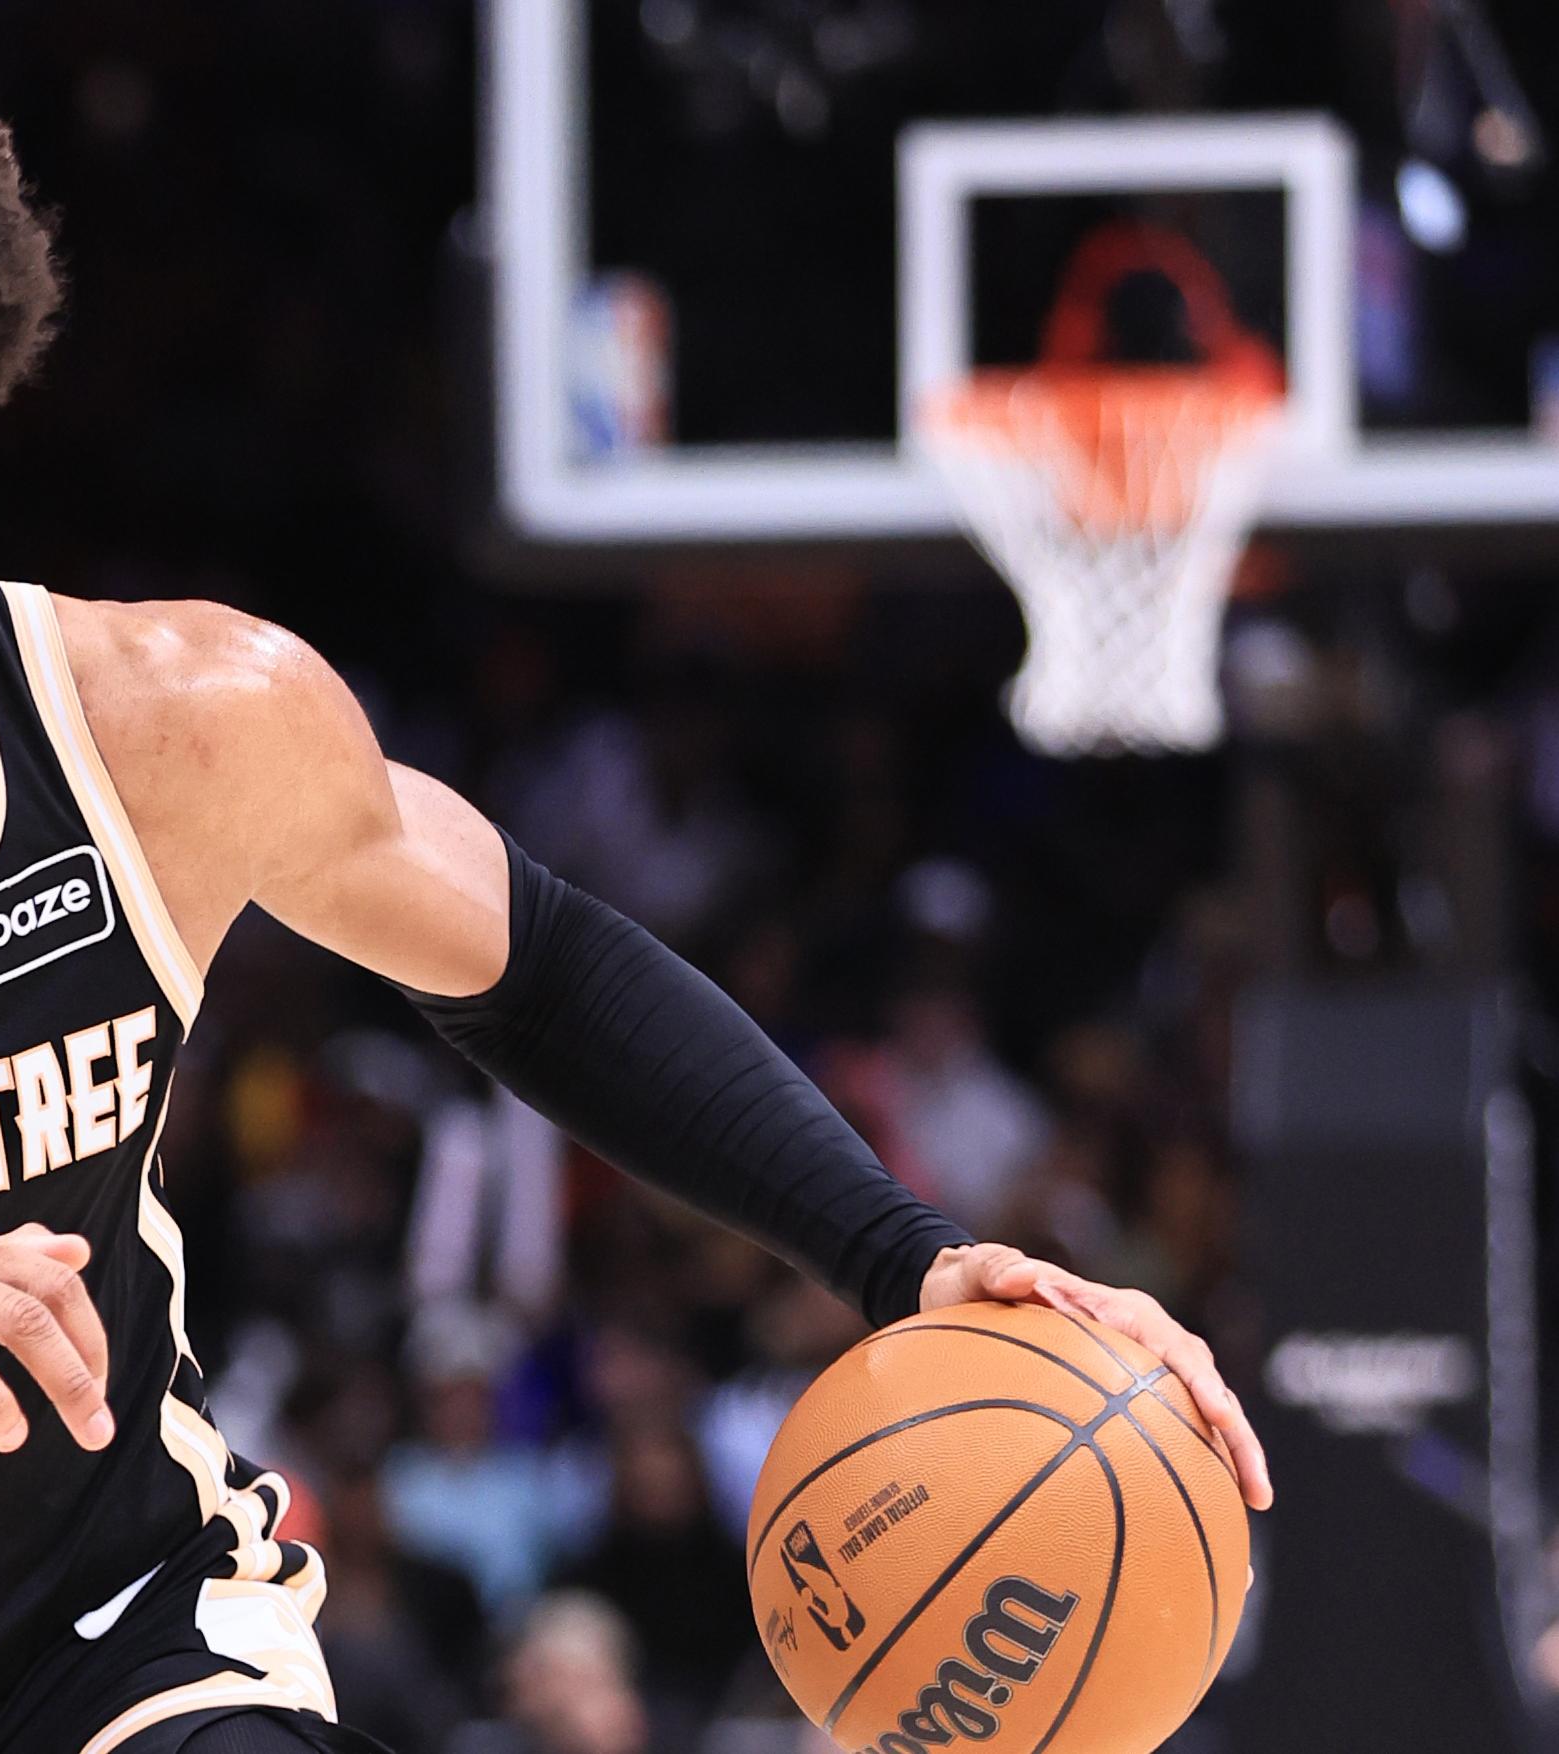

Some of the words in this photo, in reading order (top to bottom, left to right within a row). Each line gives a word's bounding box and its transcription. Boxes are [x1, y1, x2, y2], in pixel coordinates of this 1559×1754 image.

[884, 1484, 929, 1525] OFFICIAL
[858, 1515, 888, 1548] GAME
[838, 1535, 863, 1565] BALL
